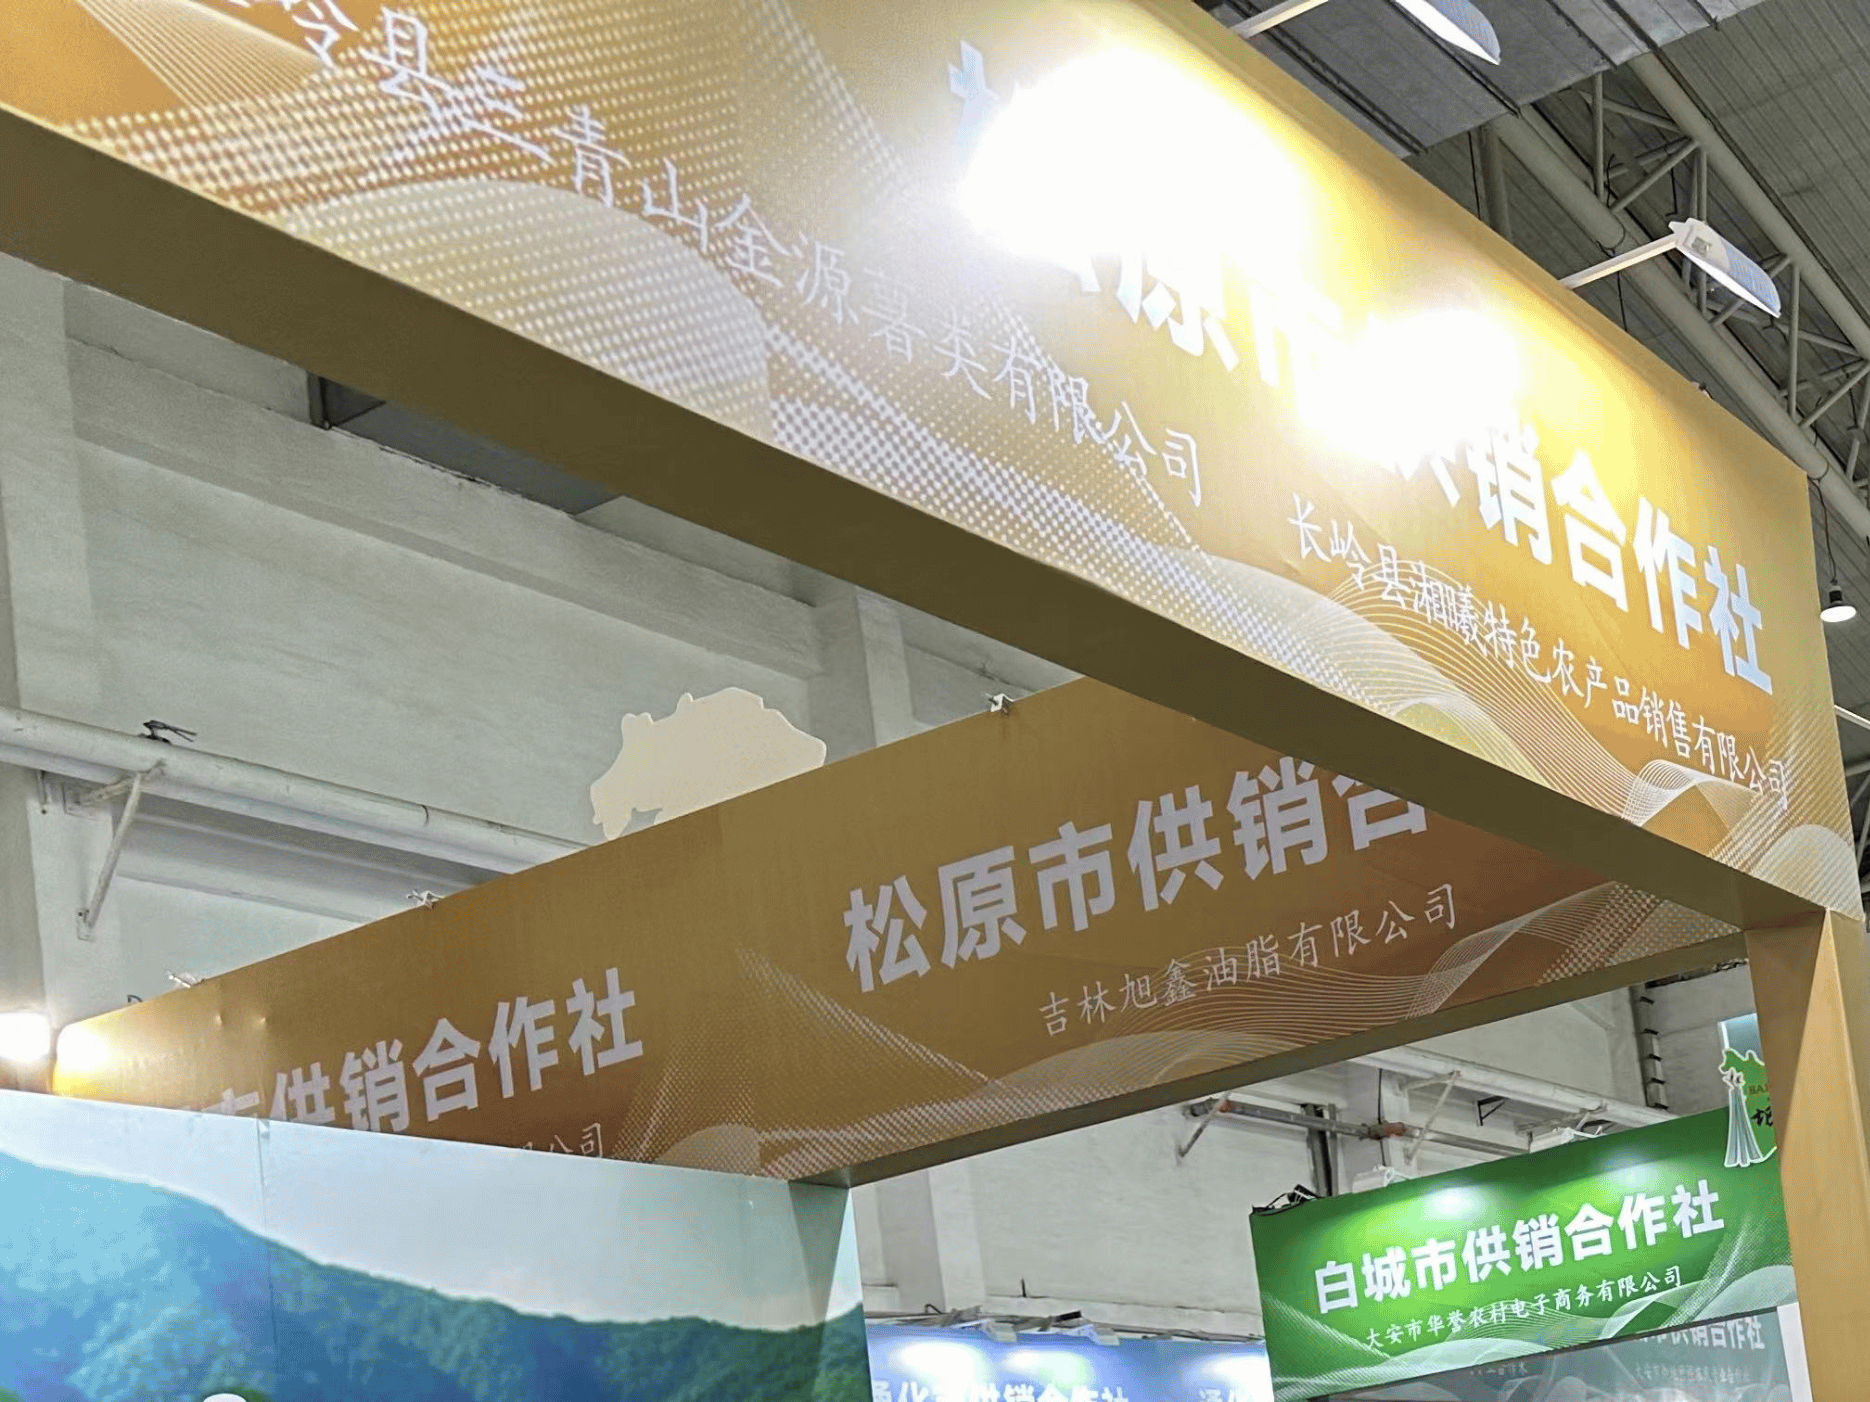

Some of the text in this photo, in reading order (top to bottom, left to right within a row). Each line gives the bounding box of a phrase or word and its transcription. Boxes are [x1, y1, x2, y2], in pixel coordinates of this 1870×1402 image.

[1038, 883, 1457, 1037] 吉林旭鑫油脂有限公司
[1314, 1182, 1726, 1314] 白城市供销合作社
